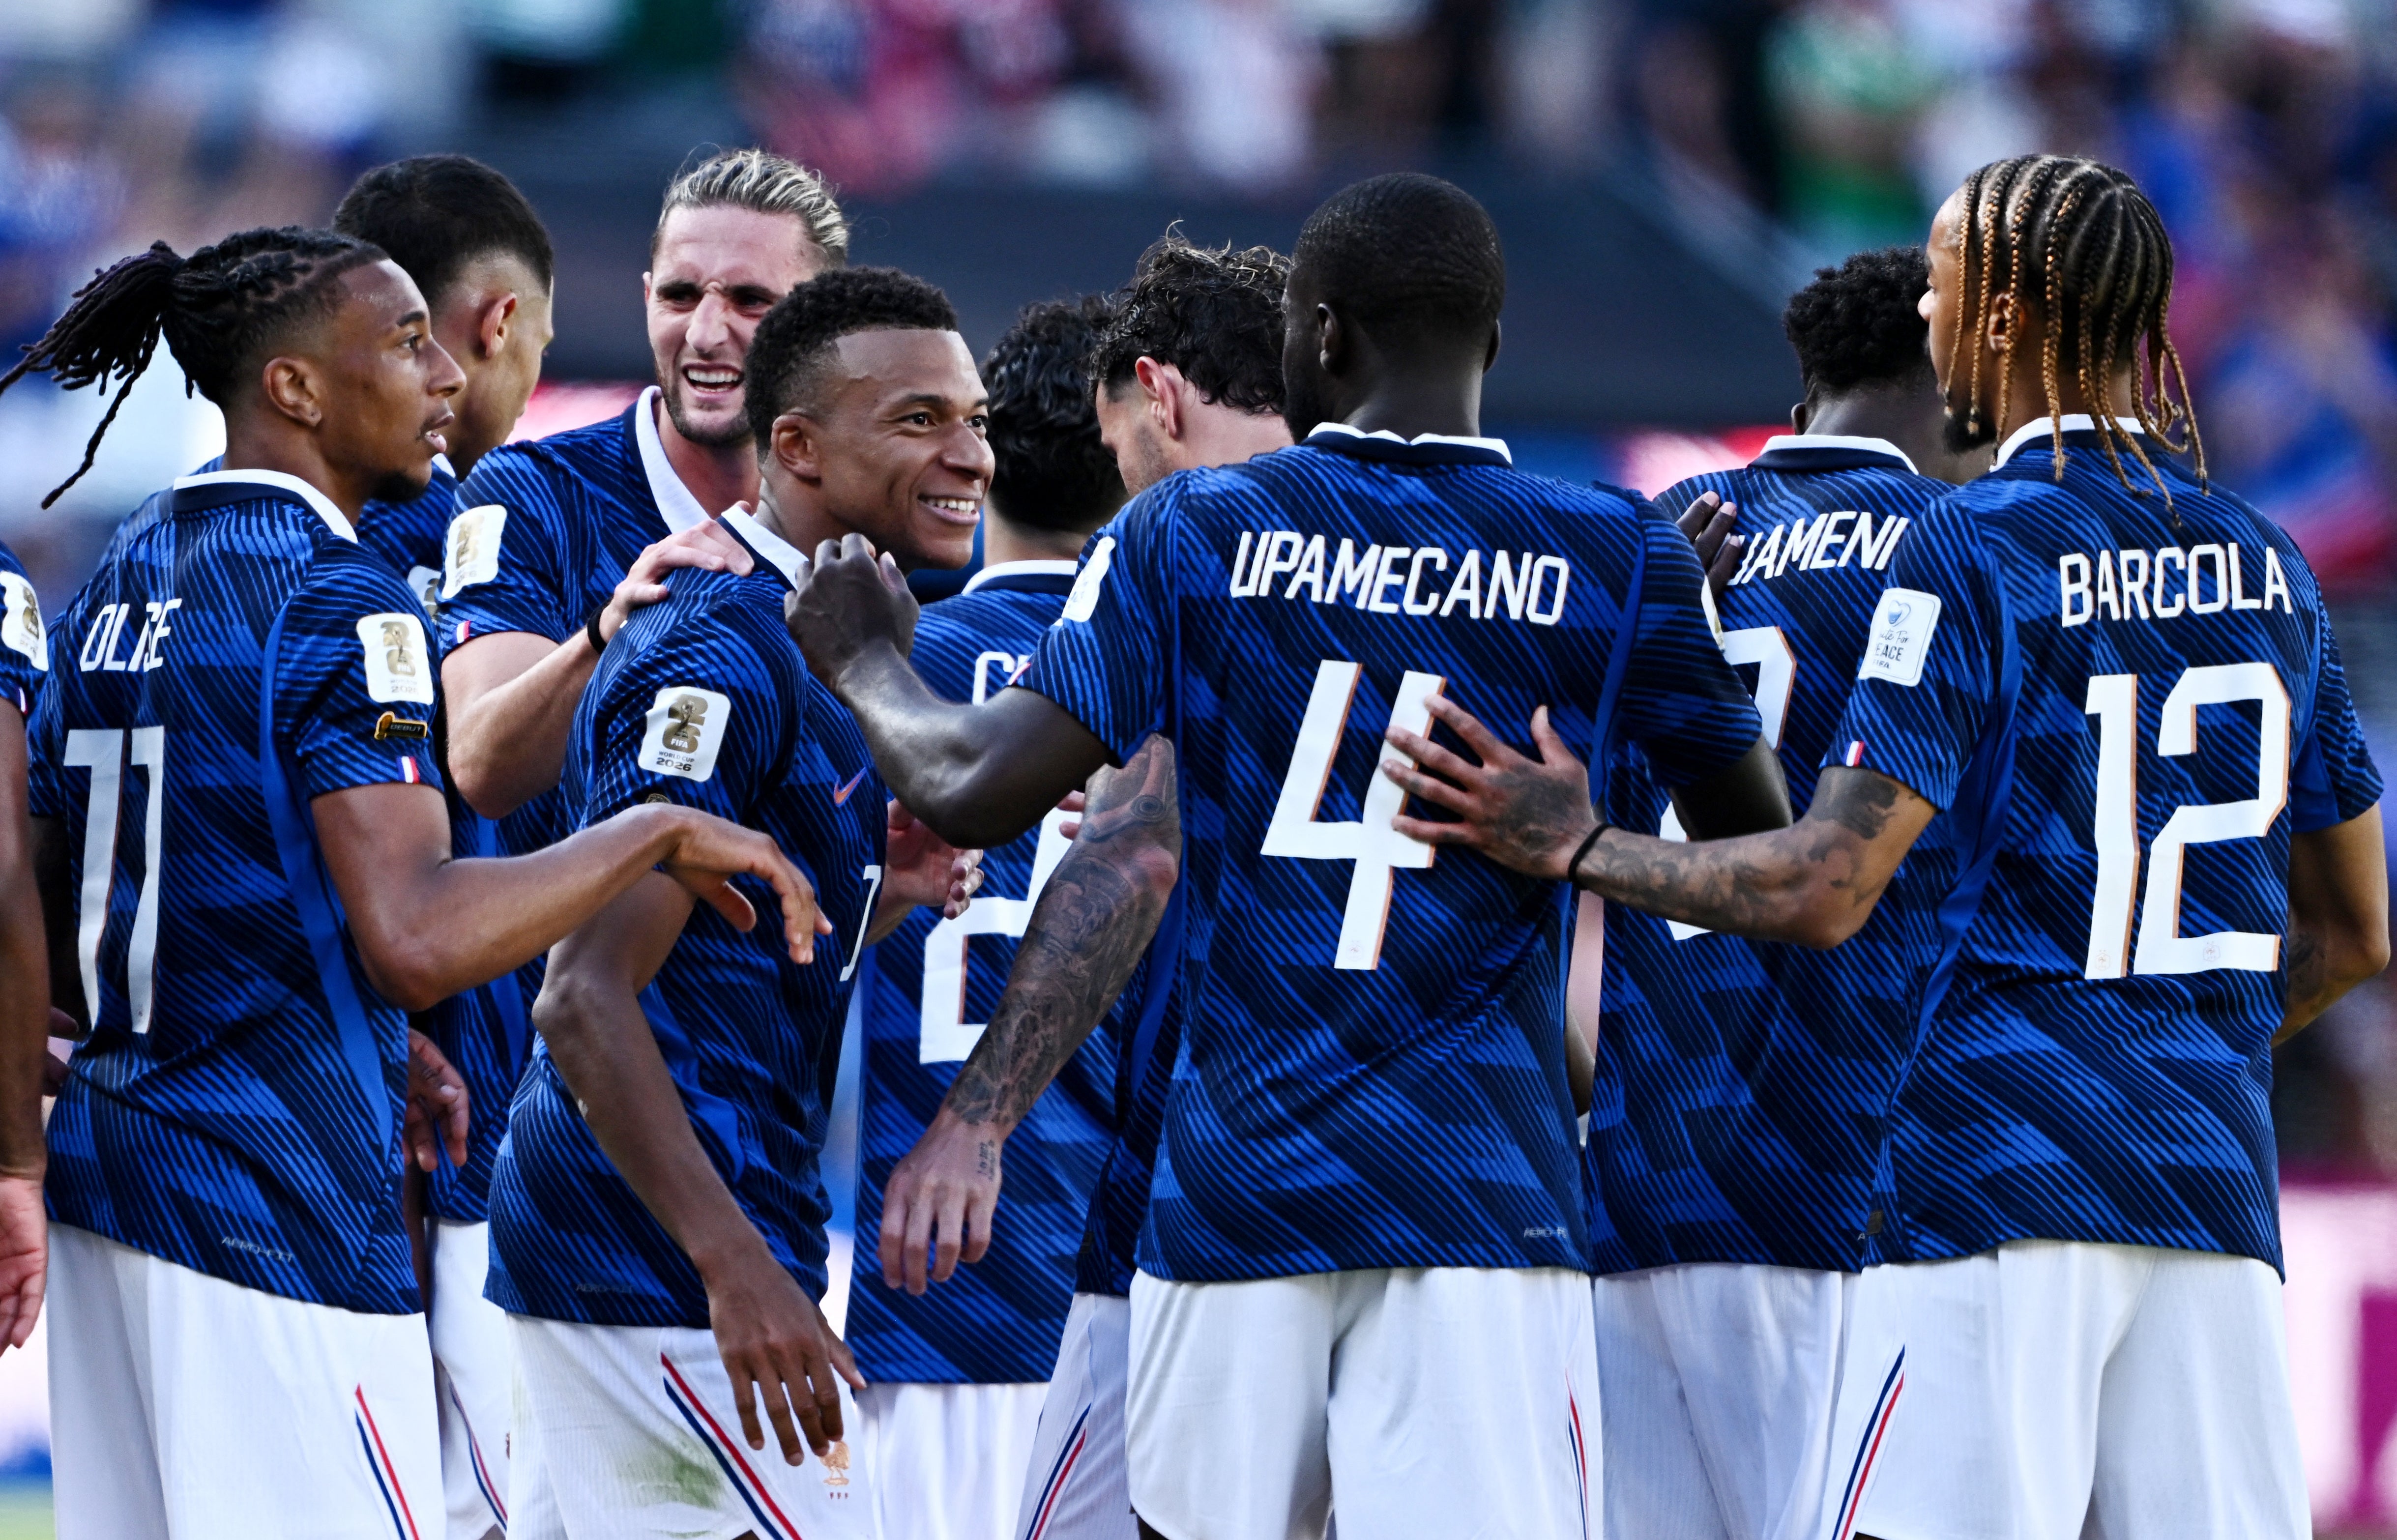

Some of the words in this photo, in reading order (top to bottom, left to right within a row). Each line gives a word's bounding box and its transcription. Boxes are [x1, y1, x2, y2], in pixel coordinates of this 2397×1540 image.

[1229, 530, 1569, 626] UPAMECANO
[2060, 542, 2292, 628] BARCOLA
[1875, 642, 1904, 662] EACE
[390, 724, 421, 732] DEBUT
[671, 738, 688, 748] FIFA
[656, 757, 692, 771] 2026
[659, 751, 681, 759] WORLD
[1260, 659, 1447, 970] 4
[2084, 661, 2292, 980] 12
[63, 726, 165, 1033] 11
